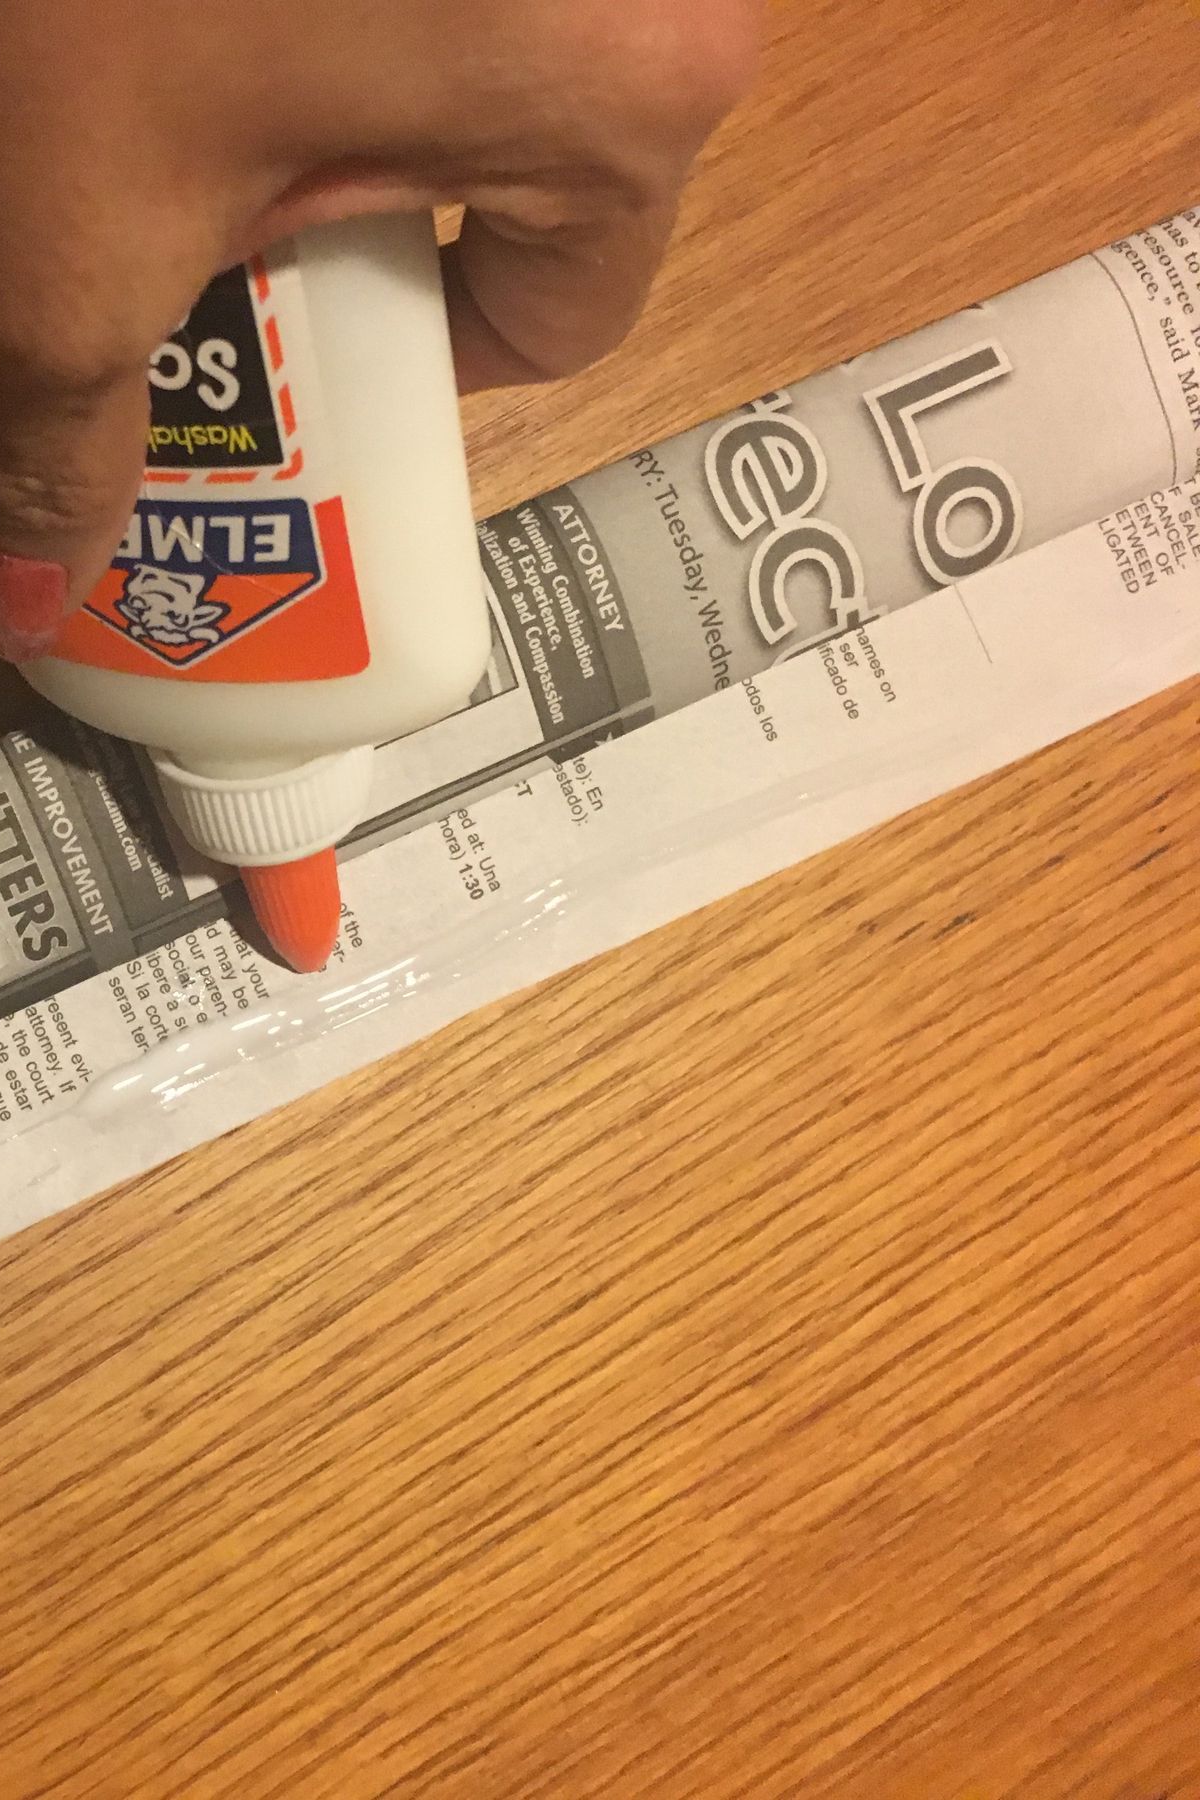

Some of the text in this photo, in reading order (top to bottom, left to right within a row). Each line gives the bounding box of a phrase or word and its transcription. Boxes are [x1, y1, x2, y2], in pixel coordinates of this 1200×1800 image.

[1133, 226, 1194, 314] resource
[1184, 251, 1200, 274] to
[1159, 316, 1191, 363] said
[704, 387, 888, 668] ect
[1097, 517, 1140, 594] LIGATED
[1114, 508, 1157, 587] ETWEEN
[1133, 497, 1175, 575] ENT OF
[1149, 489, 1187, 570] CANCEL-
[507, 536, 562, 651] of Experience,
[516, 507, 595, 679] Winning Combination
[552, 505, 625, 631] ATTORNEY
[654, 482, 708, 601] Tuesday,
[697, 599, 733, 692] Wedne
[511, 591, 537, 625] and
[525, 625, 564, 724] Compassion
[838, 642, 860, 667] ser
[850, 624, 897, 703] names on
[759, 716, 778, 742] los
[842, 698, 859, 719] de
[585, 786, 604, 811] En
[23, 756, 113, 935] IMPROVEMENT
[437, 815, 484, 901] hora) 1:30
[466, 832, 485, 854] at:
[478, 855, 501, 892] Una
[344, 920, 363, 948] the
[108, 976, 137, 1023] seran
[126, 960, 145, 980] Si
[135, 981, 150, 1001] la
[161, 938, 196, 989] social
[187, 994, 200, 1006] o
[194, 964, 227, 1017] paren-
[213, 945, 237, 980] may
[231, 985, 249, 1010] be
[241, 962, 270, 999] your
[166, 999, 179, 1011] a
[11, 1028, 31, 1057] the
[25, 1061, 55, 1105] court
[24, 1006, 77, 1093] attorney. If
[70, 1053, 93, 1083] evi-
[4, 1069, 33, 1111] estar
